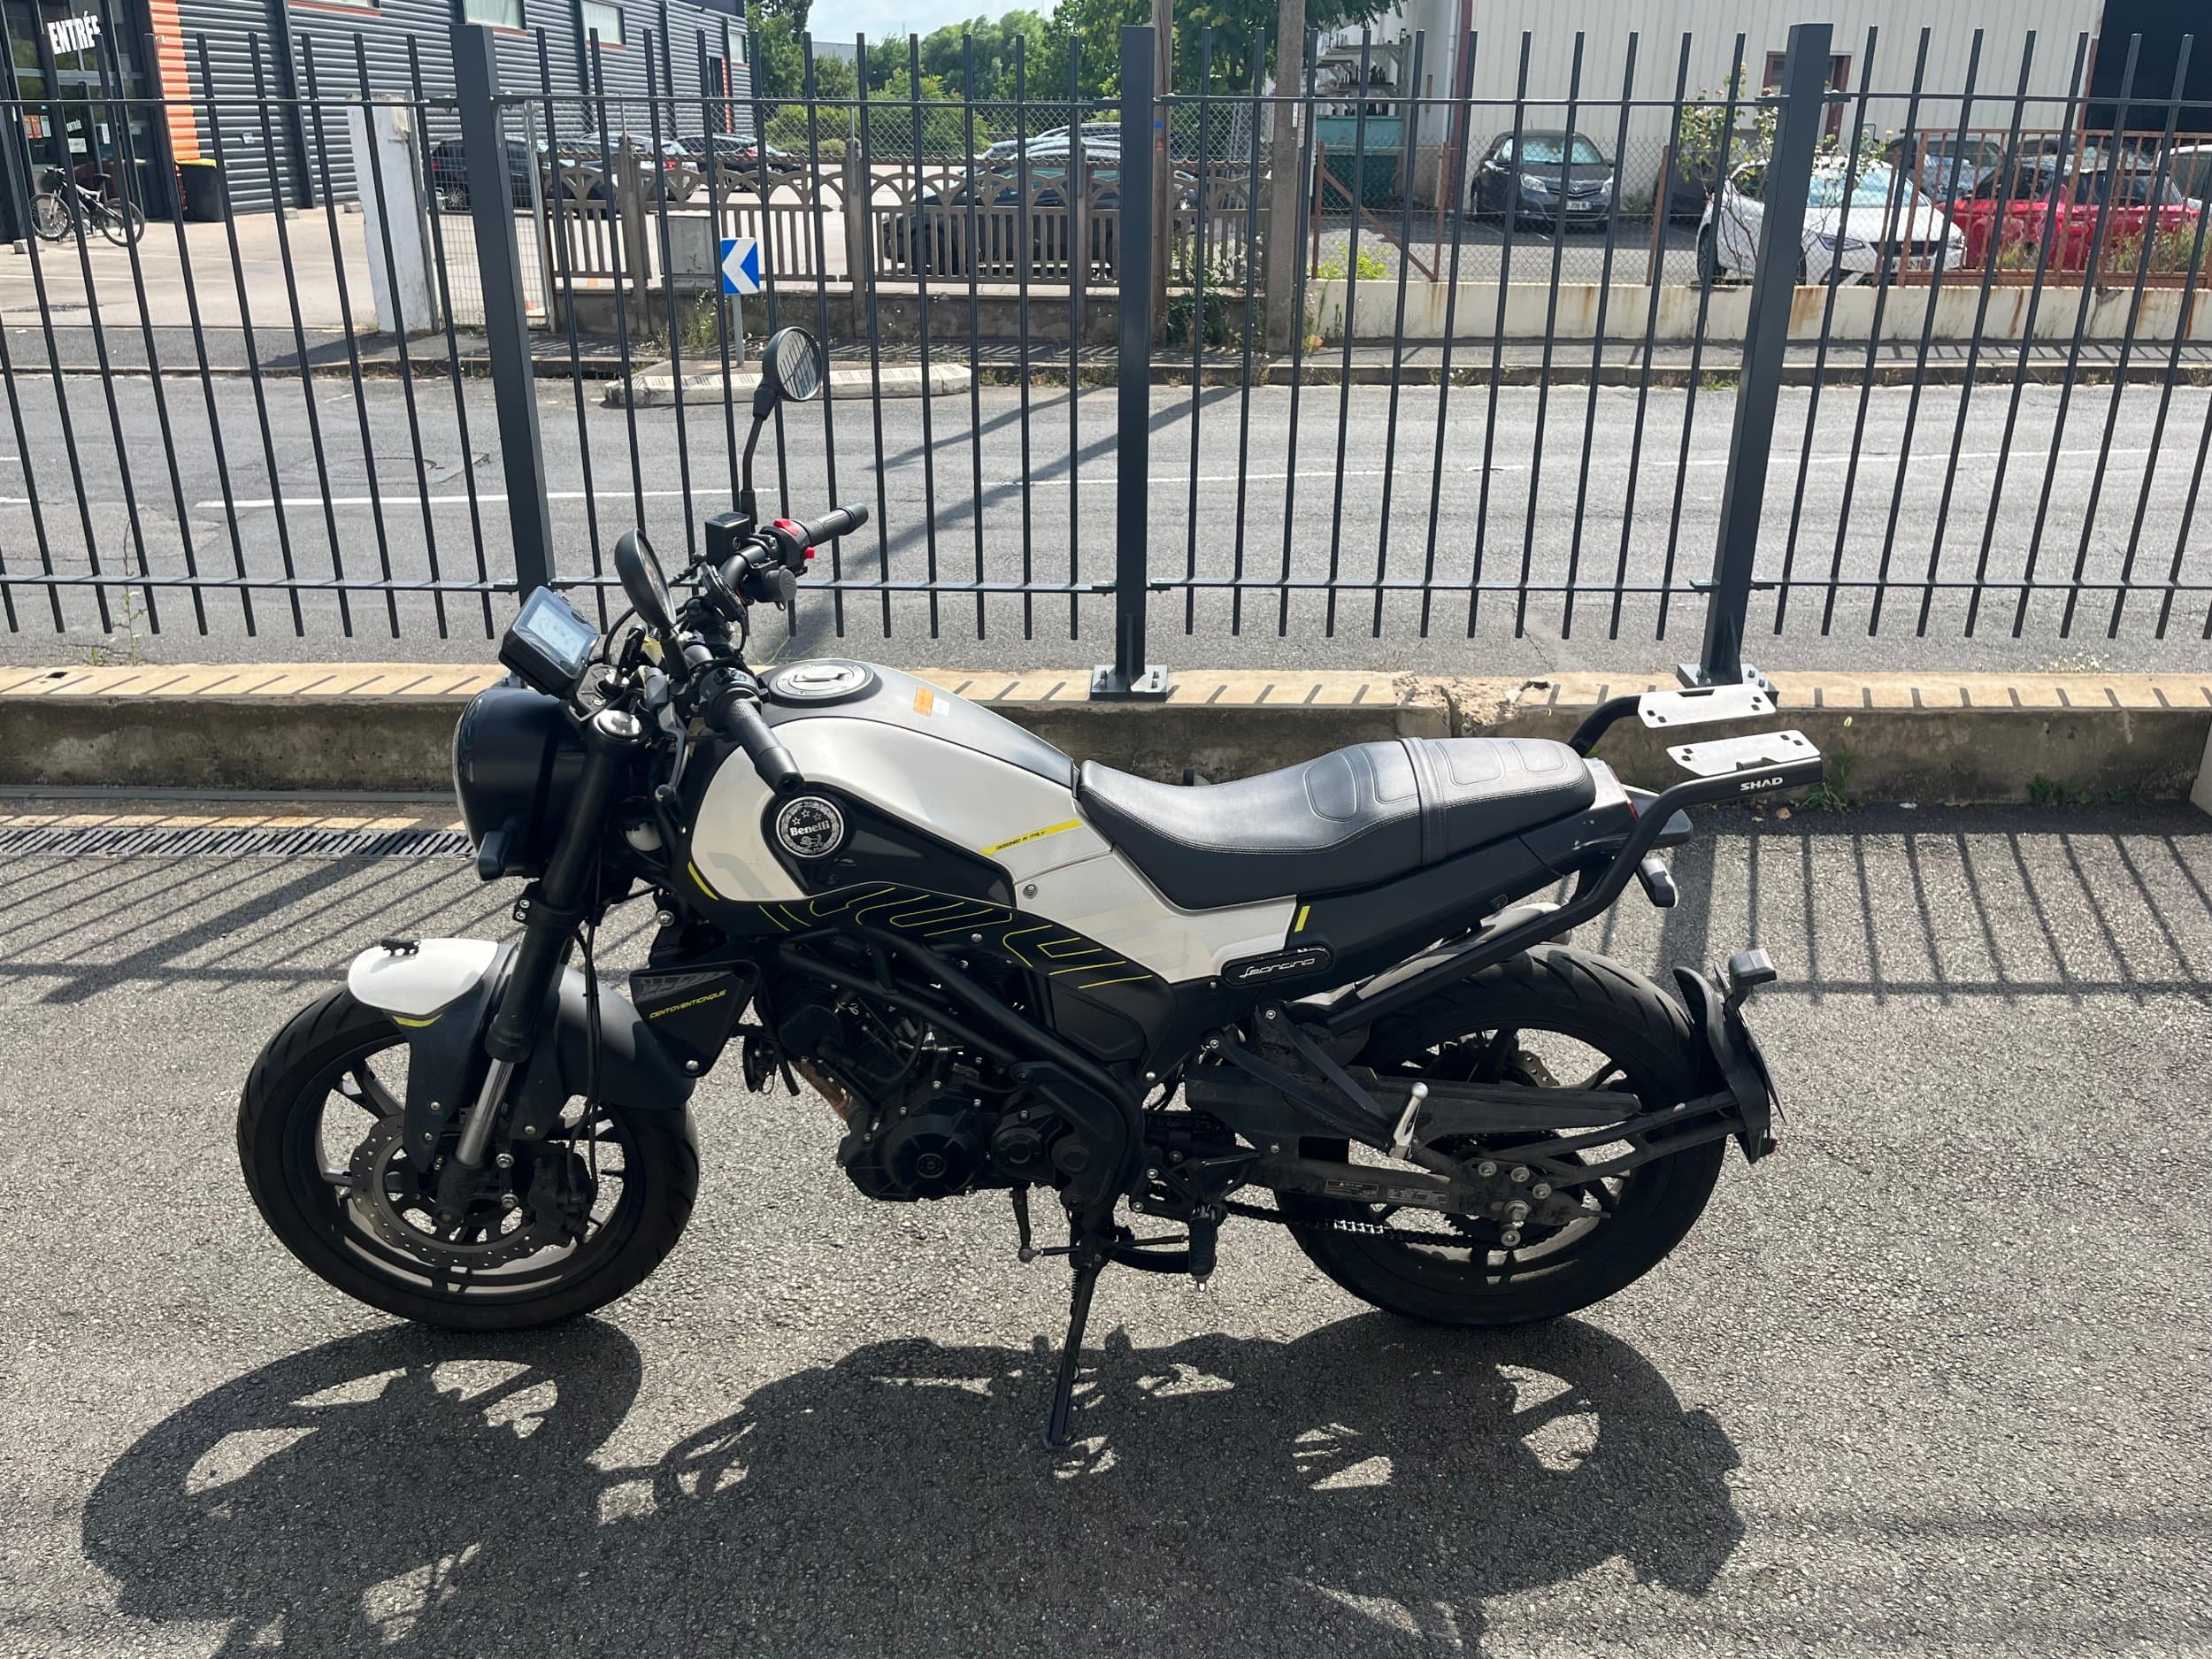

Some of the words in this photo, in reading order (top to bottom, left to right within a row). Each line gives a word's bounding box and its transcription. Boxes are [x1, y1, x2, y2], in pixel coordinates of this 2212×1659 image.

[1740, 777, 1784, 791] SHAD
[789, 819, 831, 836] Benelli
[649, 989, 727, 1019] CENTOVENTICINQUE
